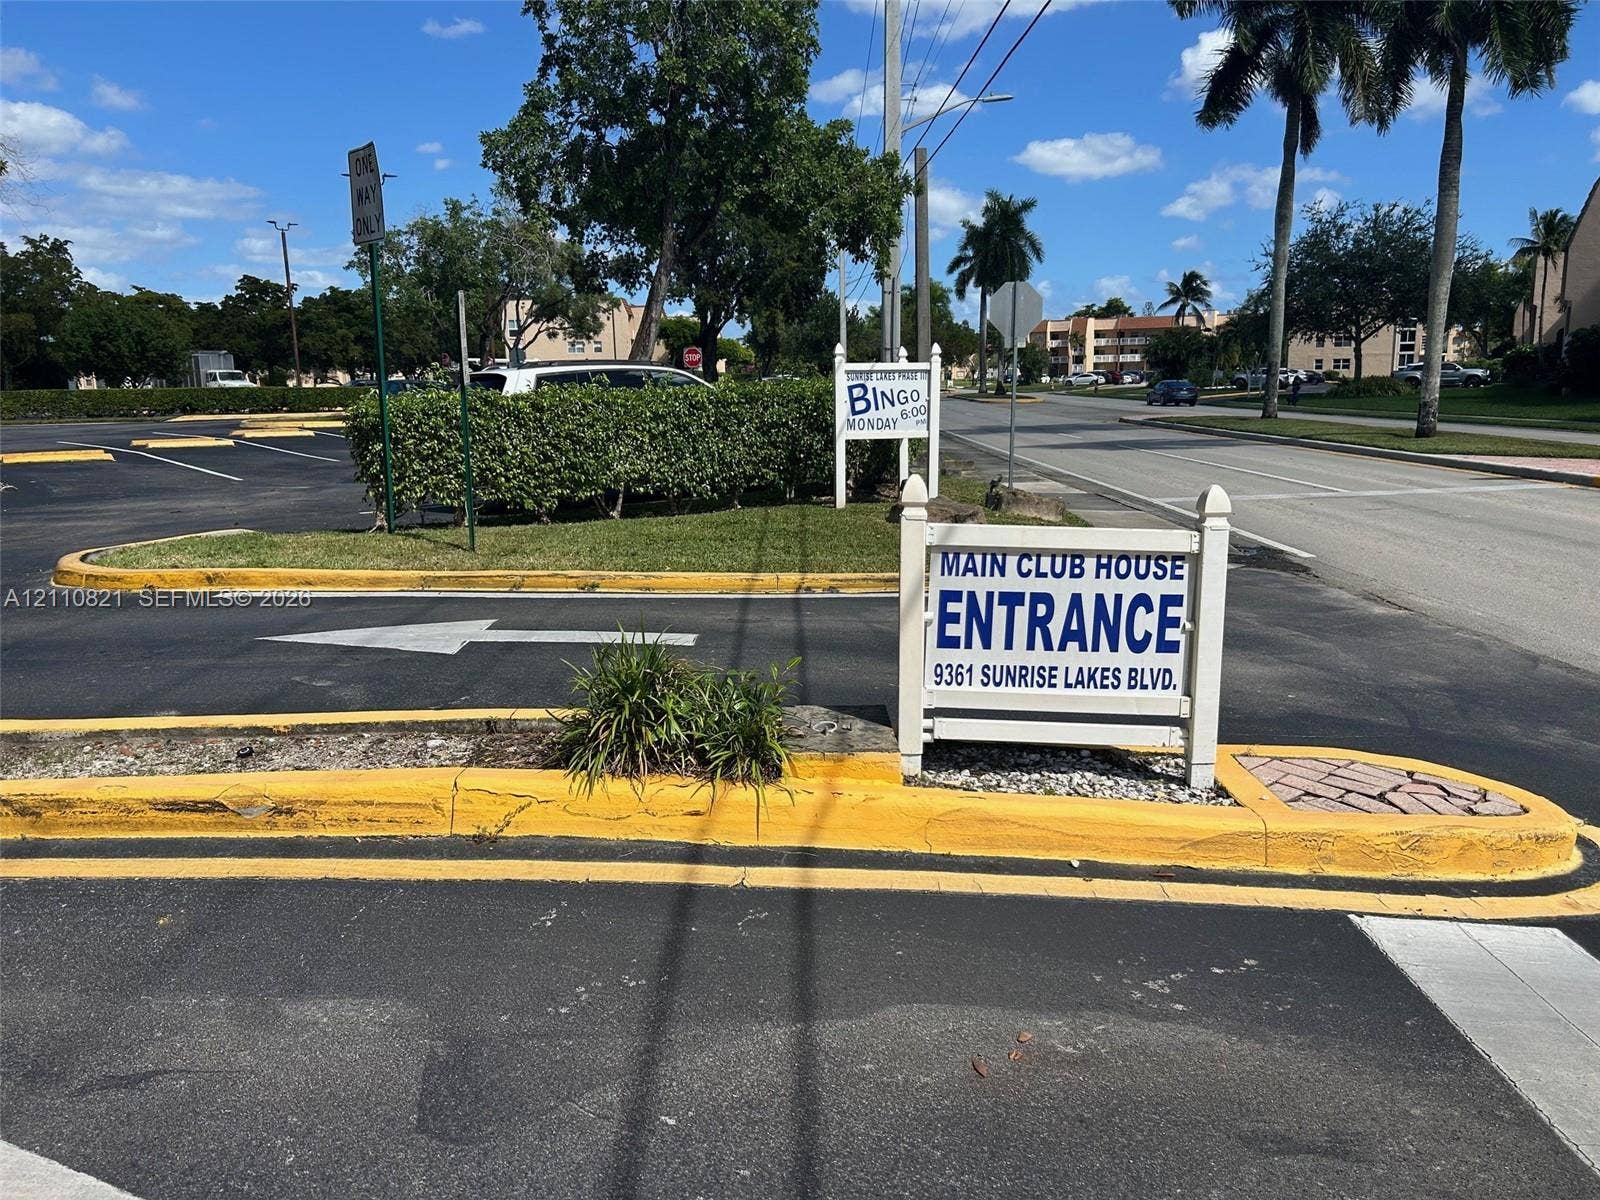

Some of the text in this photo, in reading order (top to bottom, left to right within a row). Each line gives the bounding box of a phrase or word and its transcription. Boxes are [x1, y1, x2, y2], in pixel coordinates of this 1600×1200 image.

[355, 153, 375, 177] ONE
[356, 183, 377, 207] WAY
[355, 213, 381, 237] ONLY
[846, 372, 874, 381] SUNRISE
[876, 372, 896, 381] LAKES
[898, 371, 918, 381] PHASE
[847, 383, 920, 417] BINGO
[900, 404, 927, 420] 6:00
[846, 417, 898, 431] MONDAY
[915, 418, 927, 426] PM
[940, 552, 1186, 581] MAIN CLUB HOUSE
[936, 589, 1185, 655] ENTRANCE
[933, 663, 1177, 691] 9361 SUNRISE LAKES BLVD.
